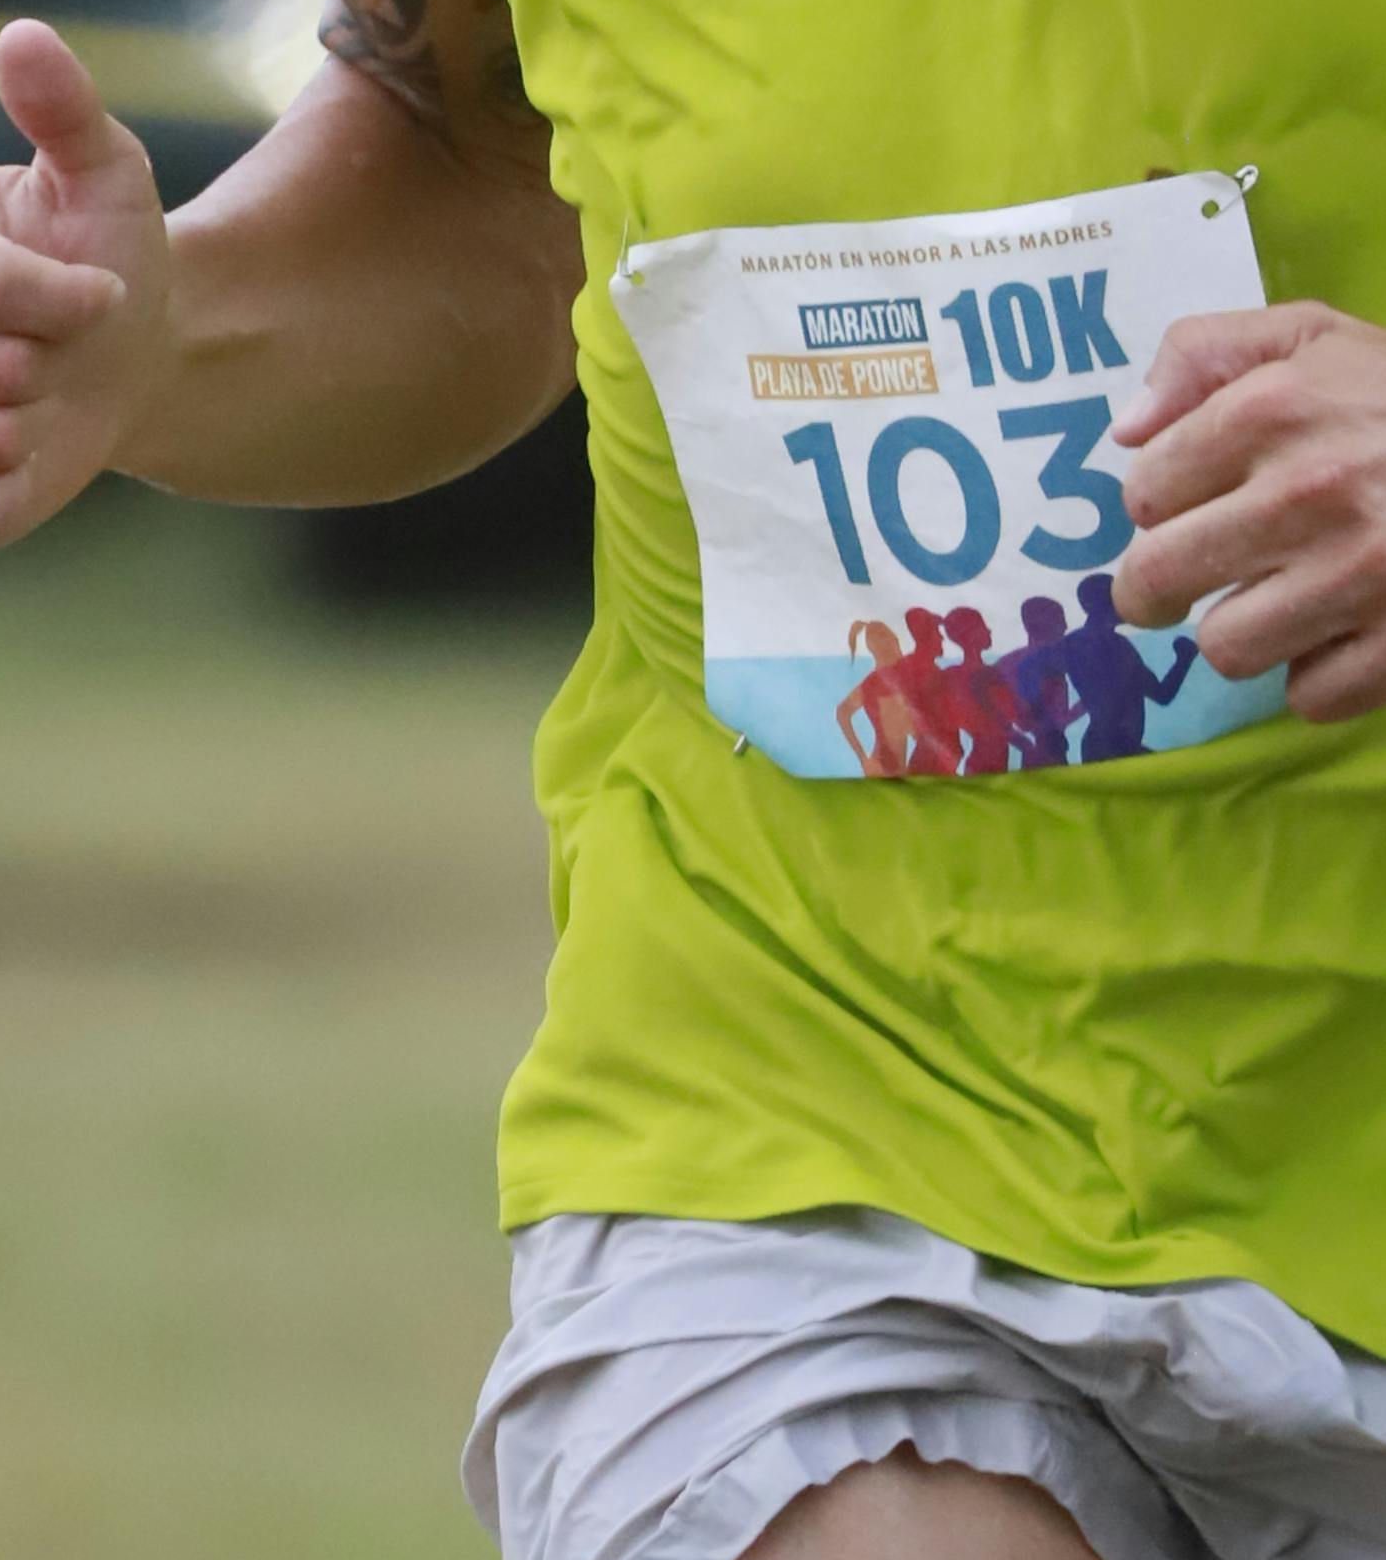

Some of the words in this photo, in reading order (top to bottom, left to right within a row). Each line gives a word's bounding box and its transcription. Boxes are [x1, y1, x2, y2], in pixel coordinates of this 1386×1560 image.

[741, 251, 833, 273] MARATÓN
[839, 251, 863, 268] EN
[868, 245, 941, 267] HONOR
[949, 243, 963, 260] A
[970, 237, 1011, 257] LAS
[1018, 220, 1112, 251] MADRES
[805, 297, 921, 345] MARATÓN
[941, 269, 1129, 388] 10K
[753, 359, 817, 396] PLAYA
[817, 361, 849, 396] DE
[851, 355, 933, 395] PONCE
[783, 395, 1136, 586] 103
